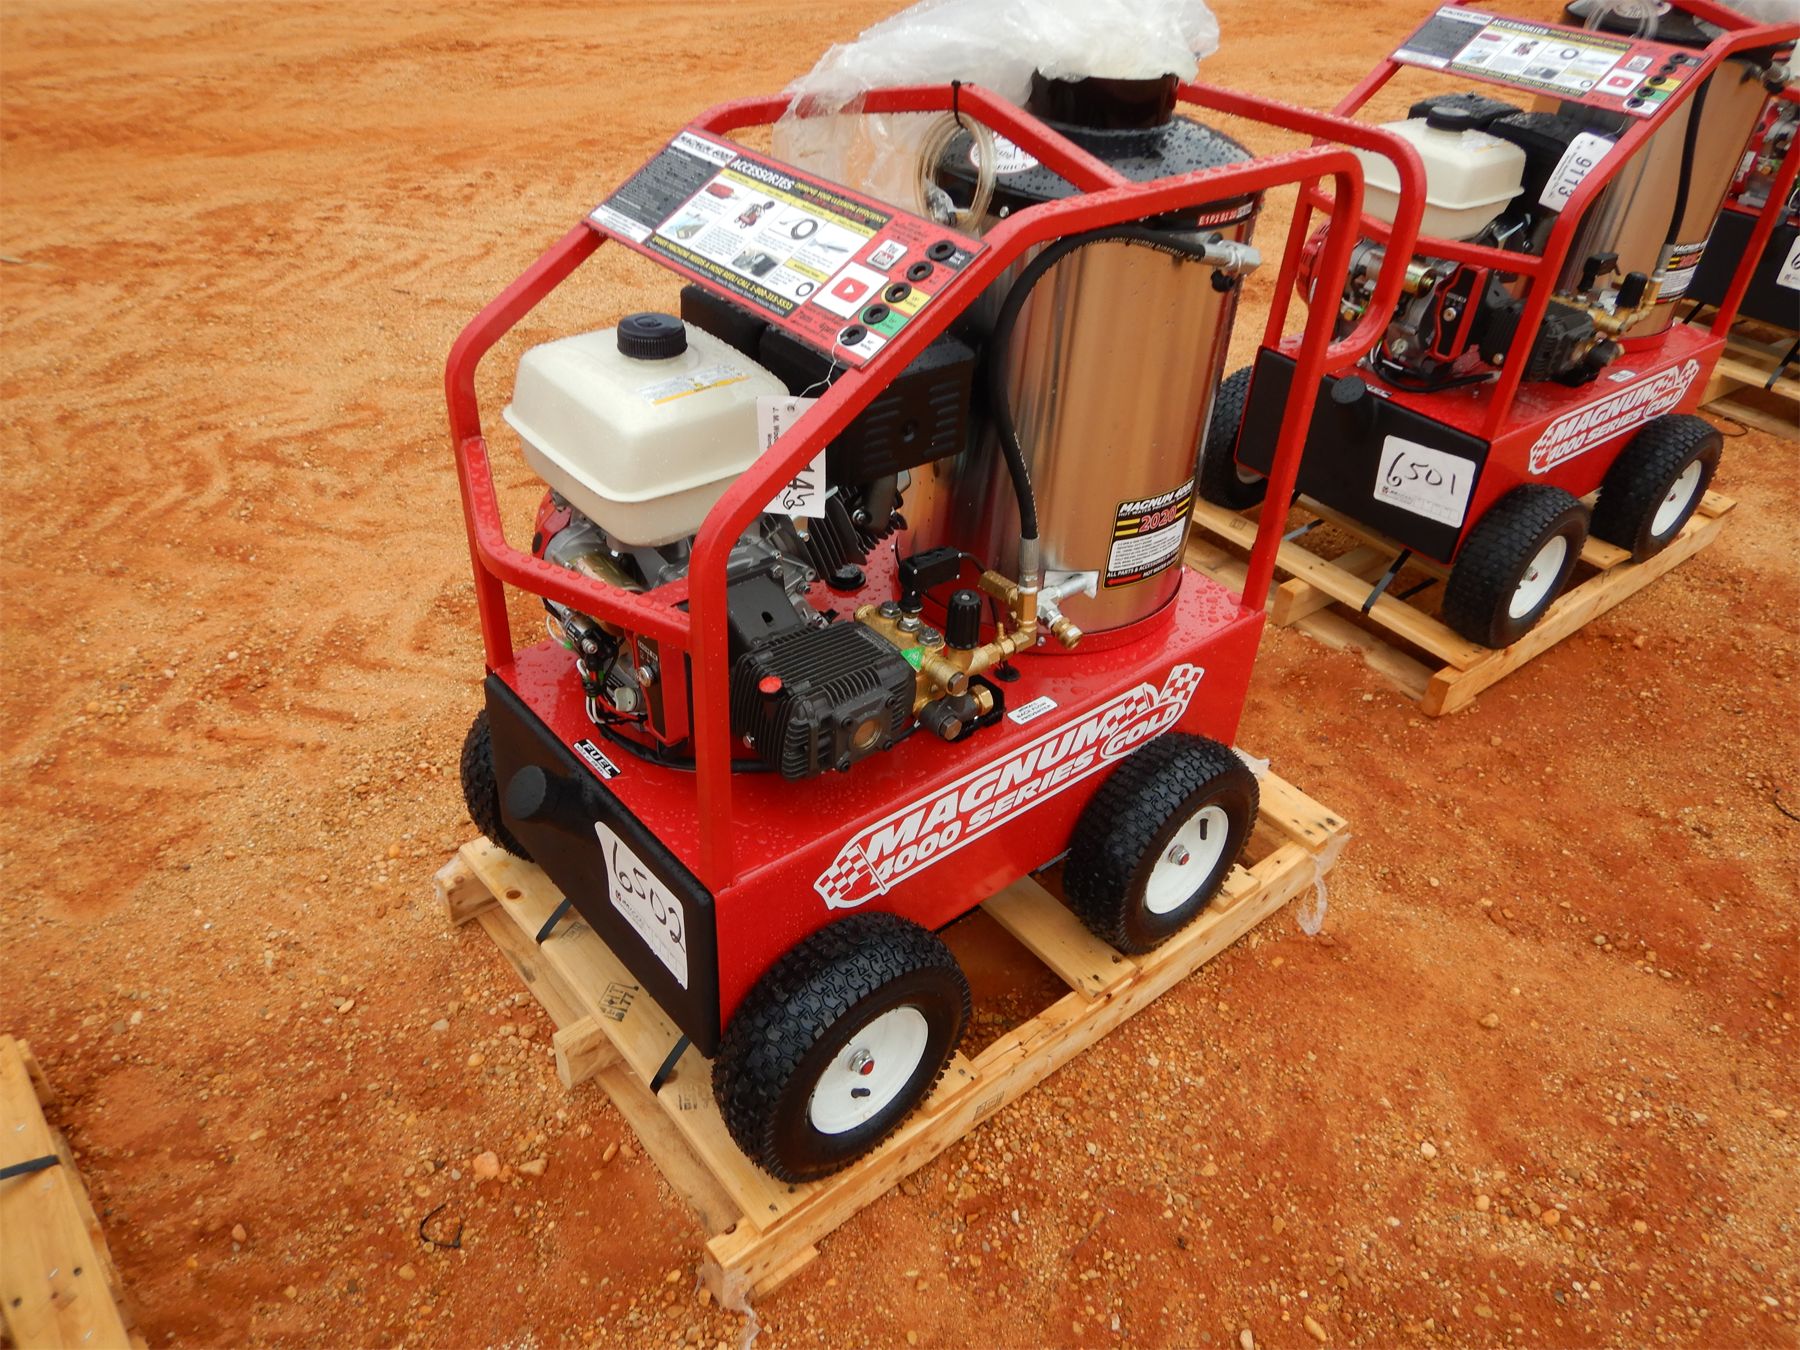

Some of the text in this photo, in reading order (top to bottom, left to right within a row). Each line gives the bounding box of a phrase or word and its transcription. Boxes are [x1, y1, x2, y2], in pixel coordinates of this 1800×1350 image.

[1492, 19, 1549, 35] ACCESSORIES
[730, 158, 795, 190] ACCESSORIES
[856, 205, 888, 223] EFFICIENCY
[1551, 379, 1664, 442] MAGNUM
[1584, 407, 1644, 443] SERIES
[1646, 391, 1683, 415] GOLD
[1387, 451, 1456, 495] 6501
[1120, 492, 1175, 513] MAGNUM
[1139, 504, 1177, 532] 2020
[1107, 570, 1117, 578] ALL
[1117, 567, 1134, 577] PARTS
[582, 743, 613, 775] FUEL
[866, 707, 1117, 862] MAGNUM
[870, 704, 1176, 886] 4000 SERIES GOLD
[613, 840, 686, 953] 6502
